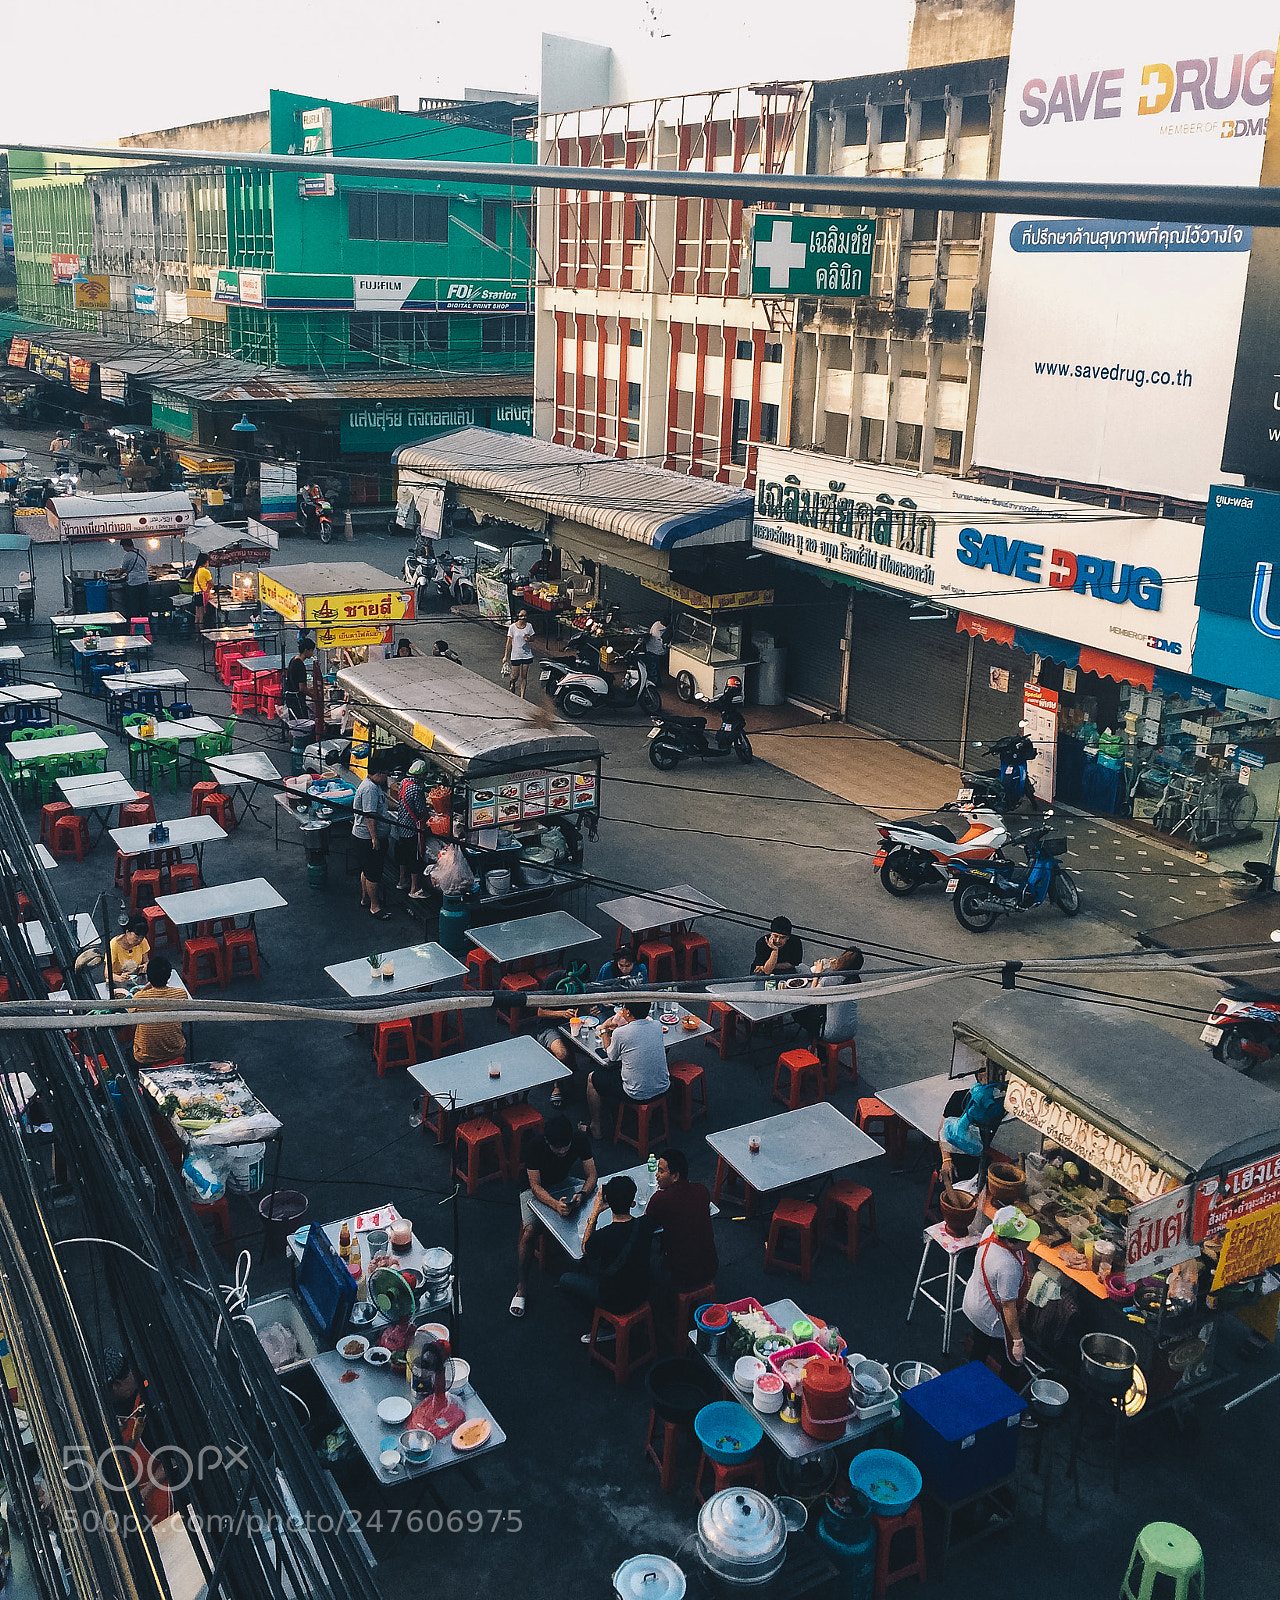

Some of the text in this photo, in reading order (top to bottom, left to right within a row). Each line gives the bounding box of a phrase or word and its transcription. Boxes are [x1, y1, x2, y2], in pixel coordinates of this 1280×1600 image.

[1019, 49, 1276, 127] SAVE DRUG
[1159, 122, 1203, 136] MEMBER
[1204, 120, 1219, 132] OF
[809, 224, 872, 254] เฉลิมชัย
[1021, 222, 1243, 249] ที่ปรึกษาด้านสุขภาพที่คุณไว้วางใจ
[359, 280, 402, 291] FUJIFILM
[816, 261, 862, 290] คลินิก
[1034, 360, 1193, 388] www.savedrug.co.th
[957, 528, 1163, 612] SAVE DRUG
[343, 593, 392, 618] ชายสี่
